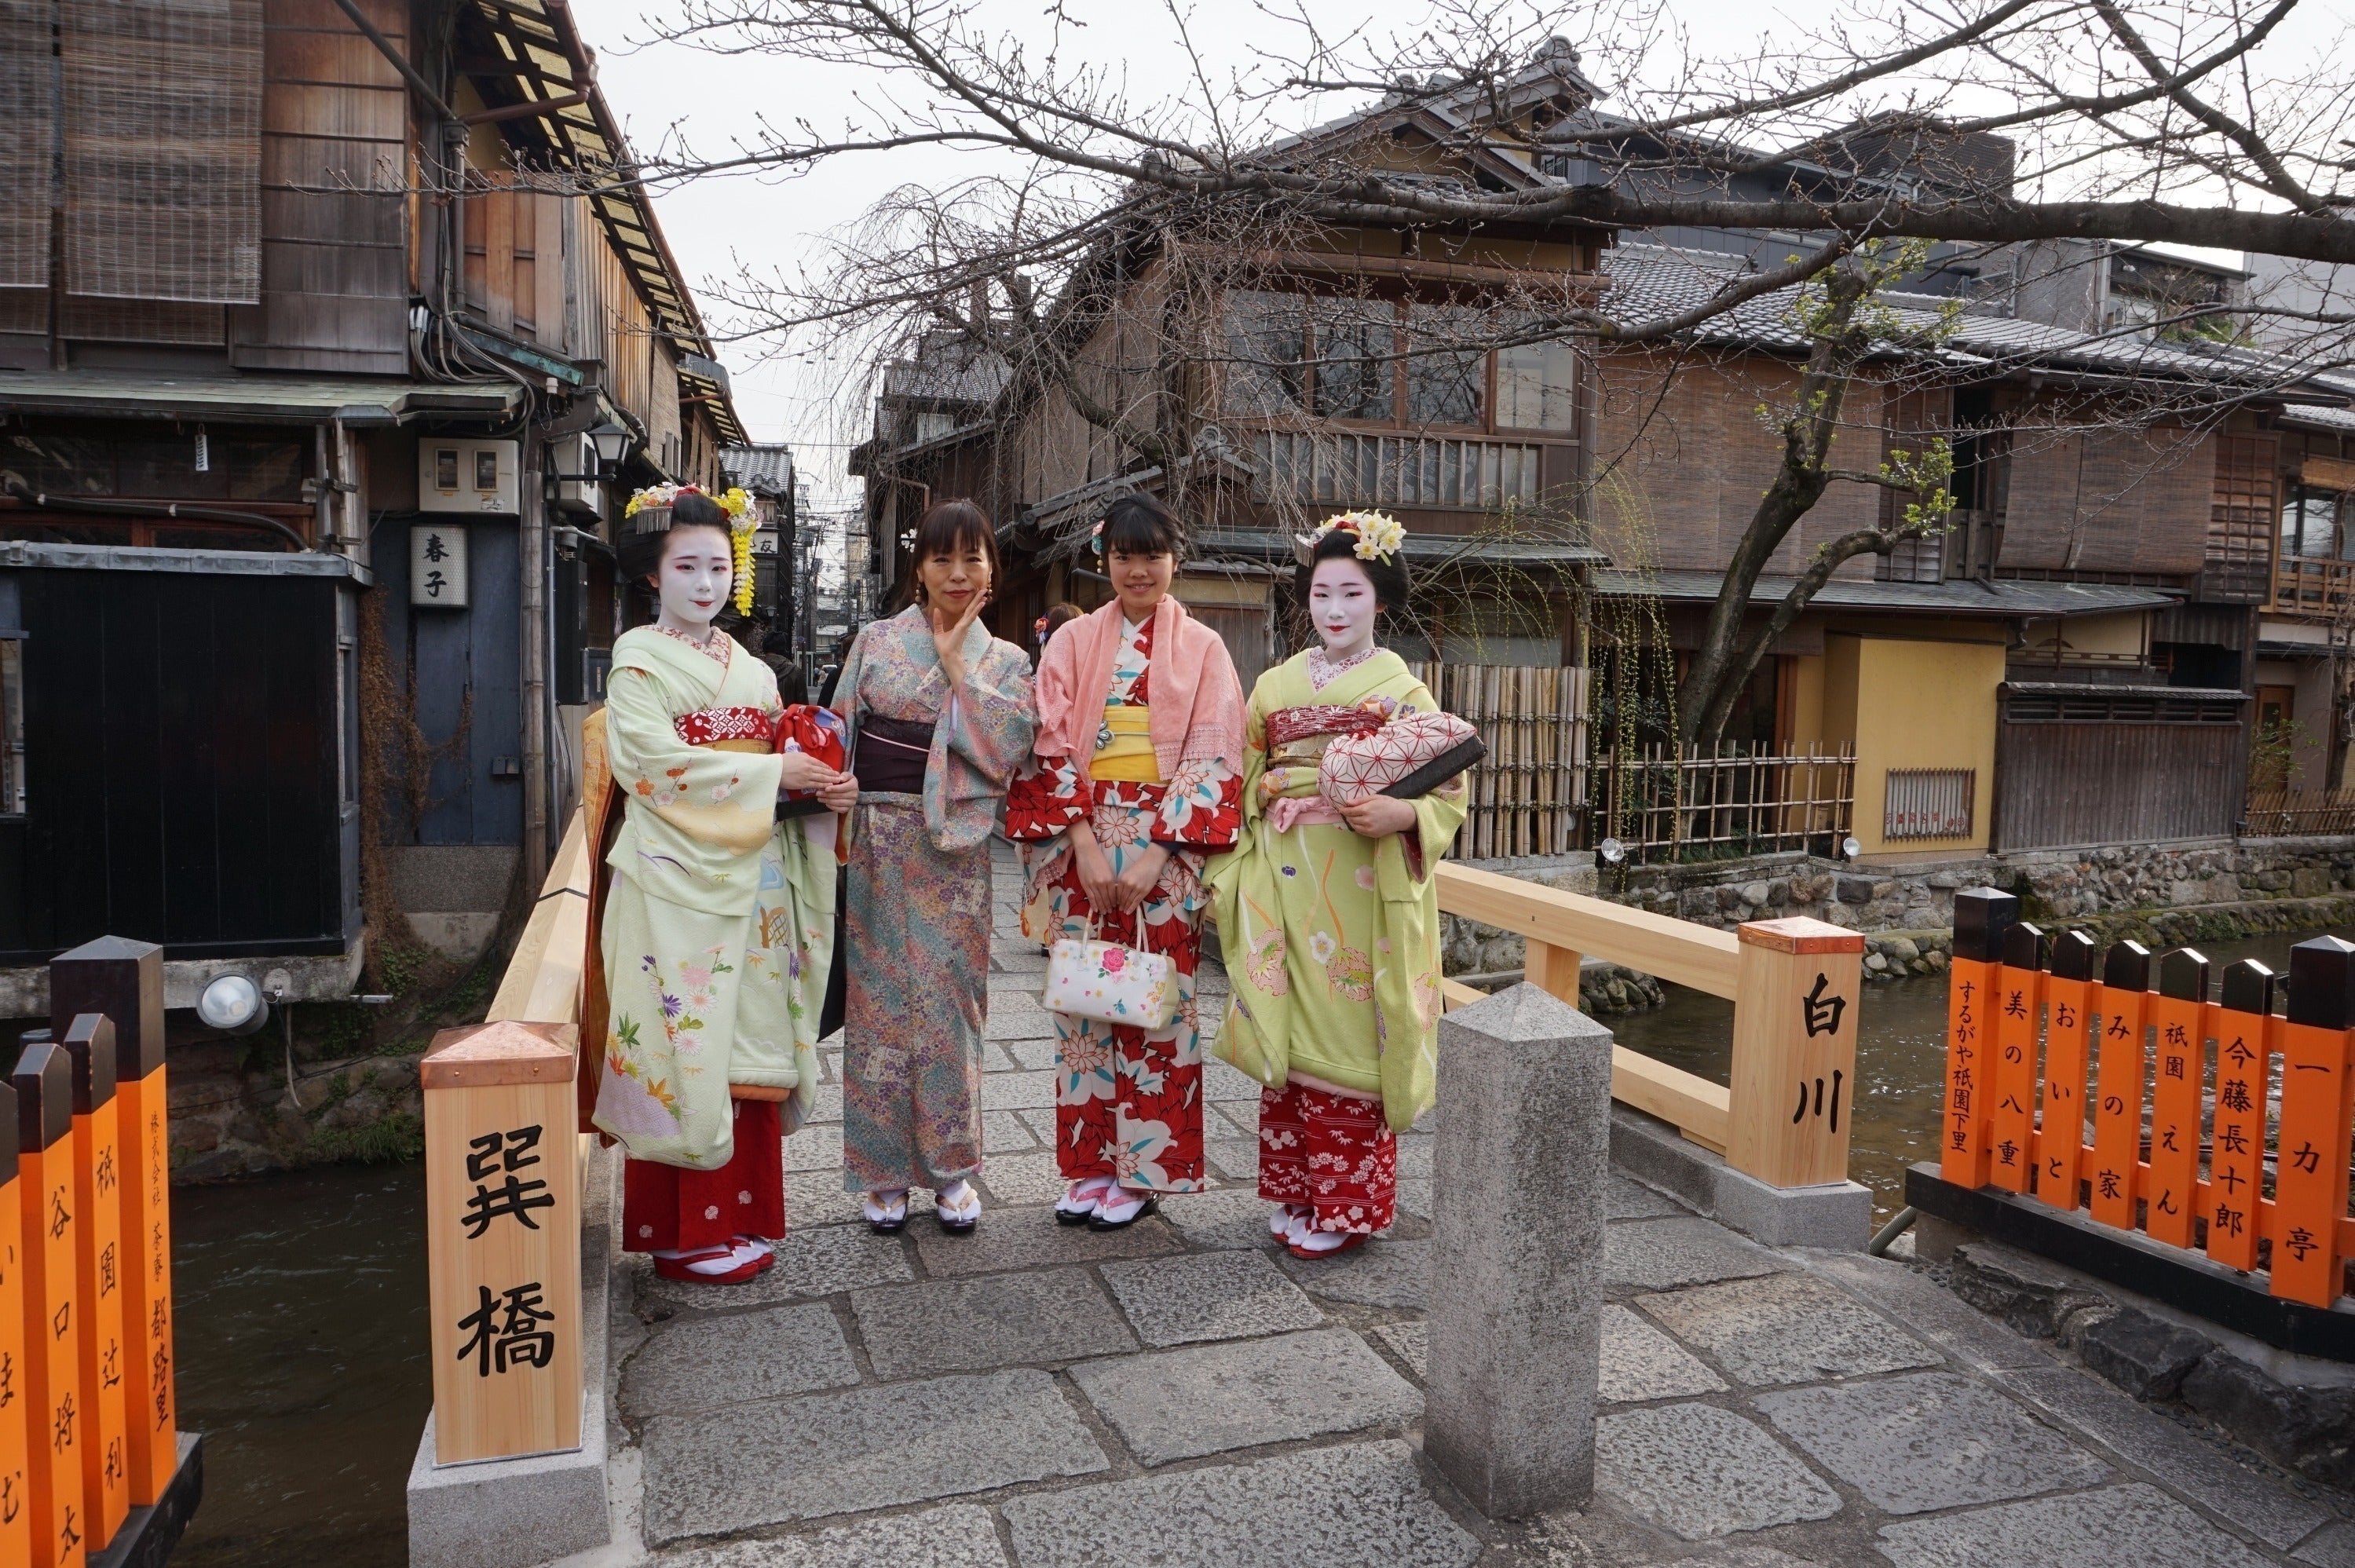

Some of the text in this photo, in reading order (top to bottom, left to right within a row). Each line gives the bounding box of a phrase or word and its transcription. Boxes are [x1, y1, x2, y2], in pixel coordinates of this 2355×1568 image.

[422, 533, 450, 598] 春子
[1794, 973, 1846, 1134] 白川
[1951, 981, 1976, 1153] するがや祇園下里
[1998, 990, 2028, 1167] 美の八重
[2049, 1002, 2075, 1179] おいと
[2099, 1015, 2130, 1200] みの家
[2216, 1036, 2256, 1238] 今藤長十郎
[457, 1124, 555, 1377] 巽橋
[2286, 1063, 2331, 1263] 一力亭
[49, 1185, 82, 1565] 谷口将太
[96, 1144, 123, 1489] 祇園辻利
